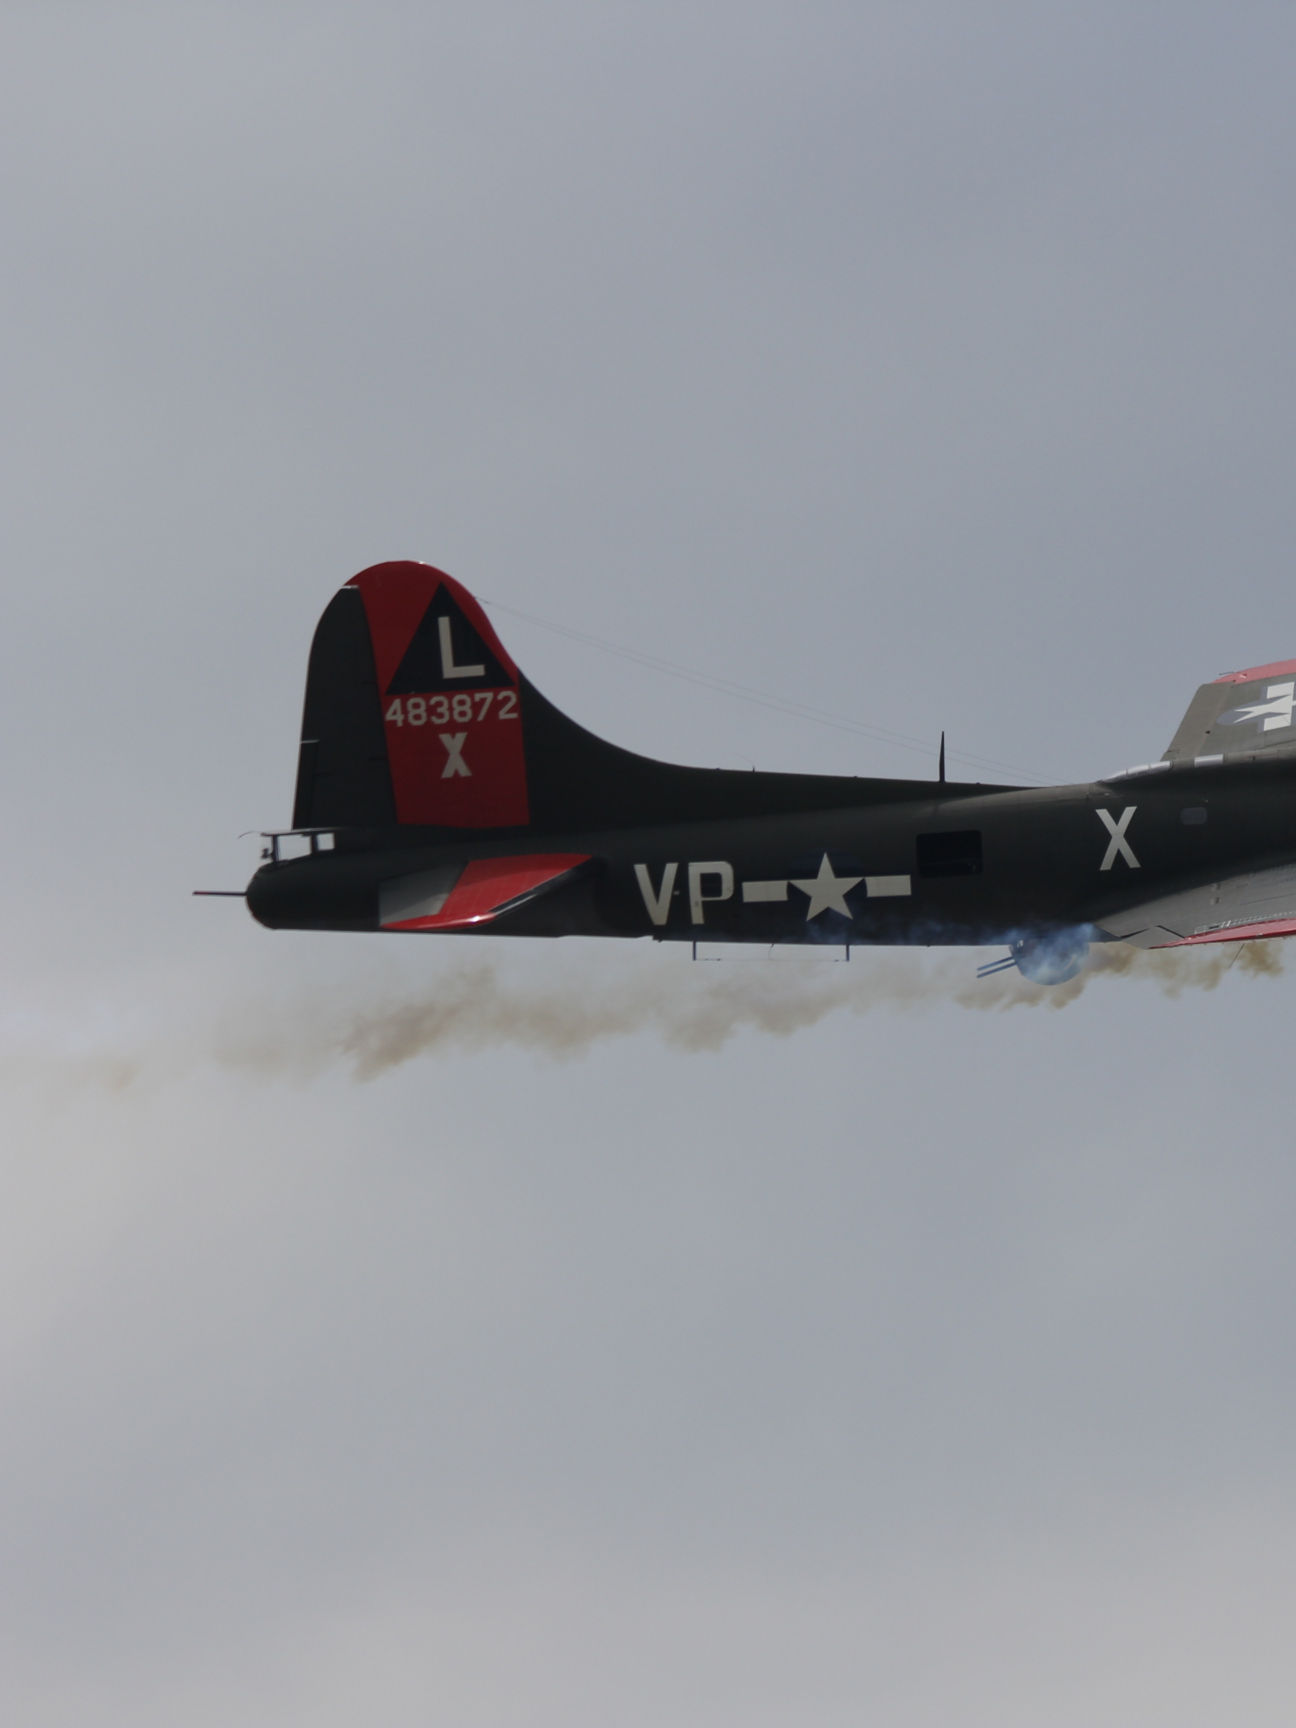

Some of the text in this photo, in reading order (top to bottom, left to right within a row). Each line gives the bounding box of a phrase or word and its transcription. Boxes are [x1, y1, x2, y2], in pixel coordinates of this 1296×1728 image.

[438, 616, 485, 679] L
[385, 690, 518, 727] 483872
[439, 732, 472, 778] X
[1095, 806, 1141, 871] X
[634, 860, 734, 925] VP
